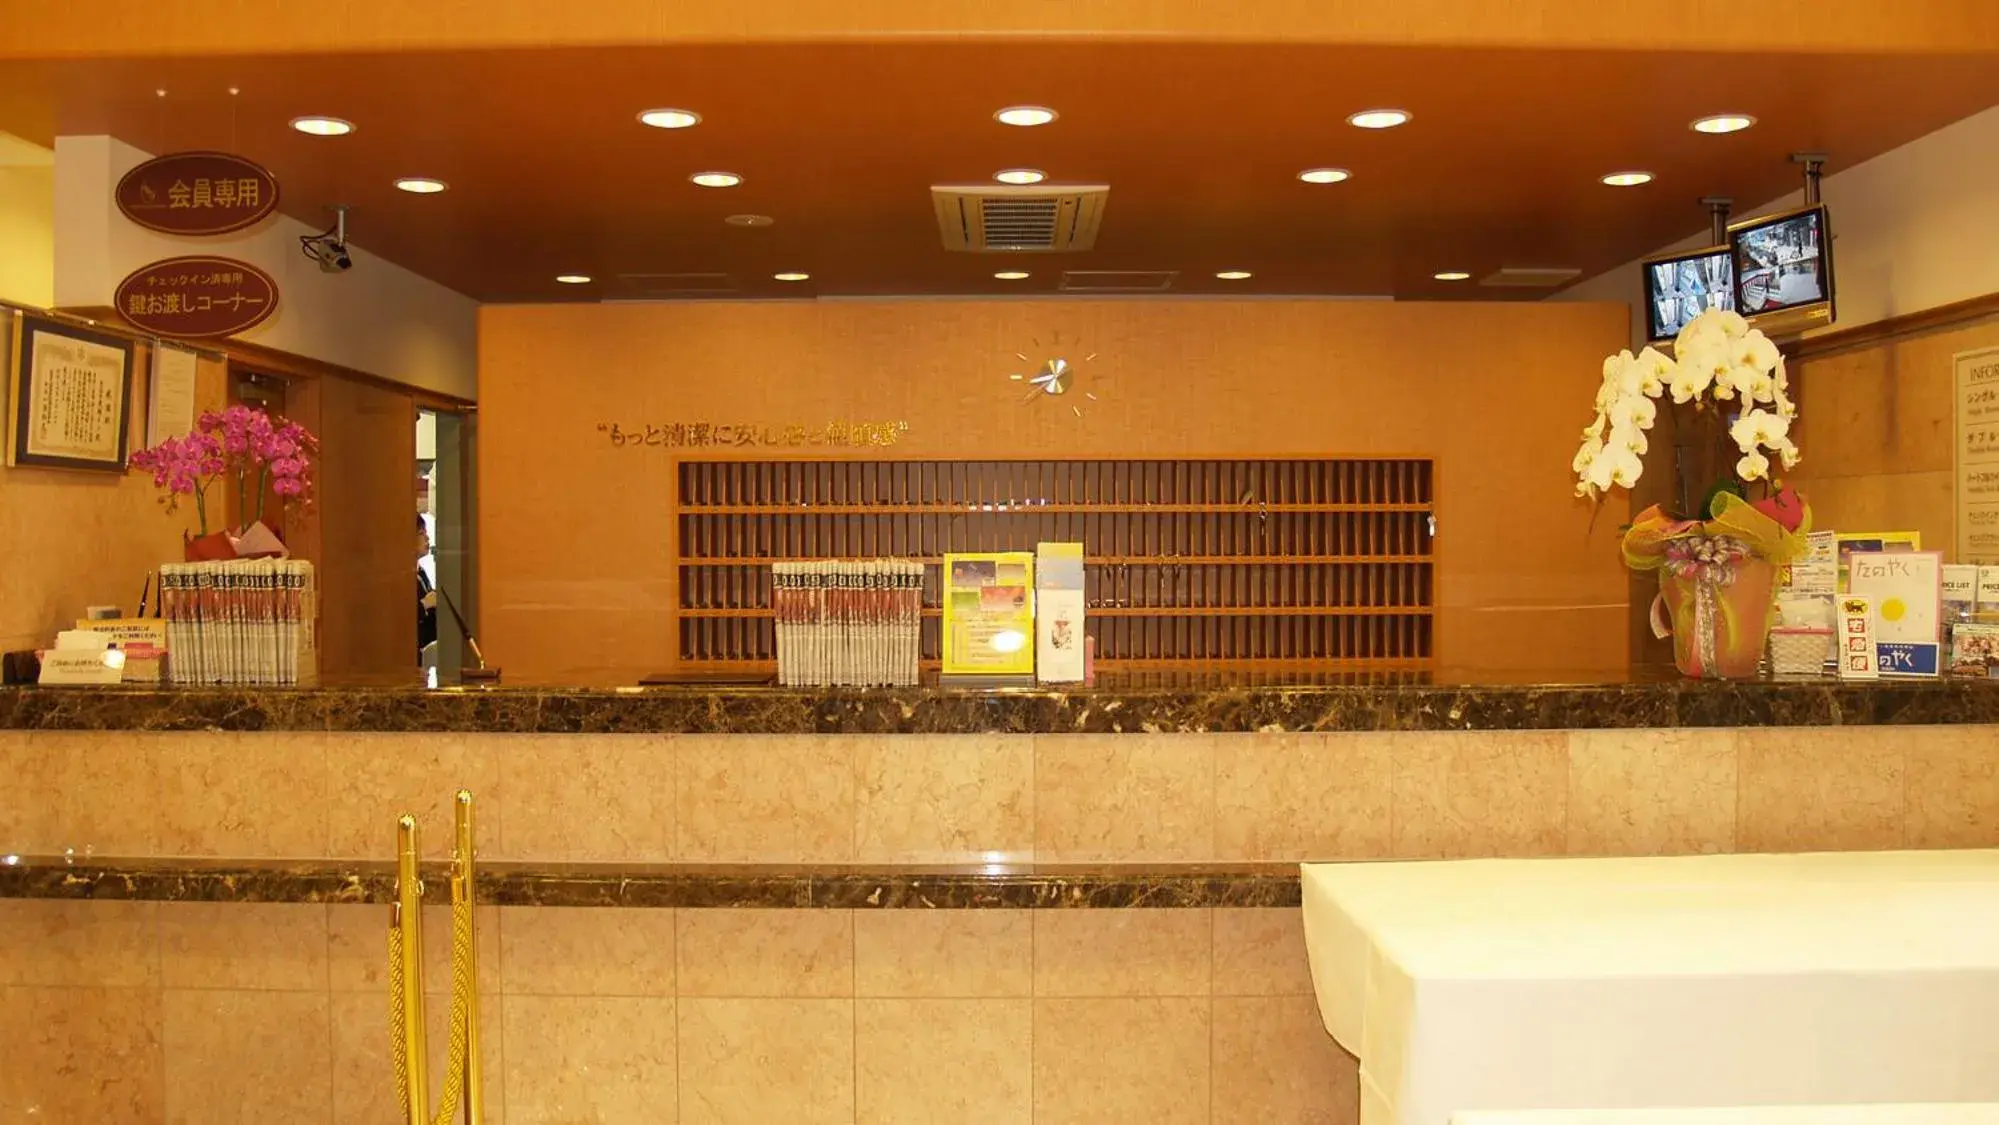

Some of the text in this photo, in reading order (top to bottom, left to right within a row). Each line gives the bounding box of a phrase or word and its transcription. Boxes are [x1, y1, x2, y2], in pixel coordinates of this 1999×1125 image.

[168, 178, 260, 209] 会員専用
[128, 290, 264, 316] 鍵お渡しコーナー
[1879, 650, 1914, 667] のやく
